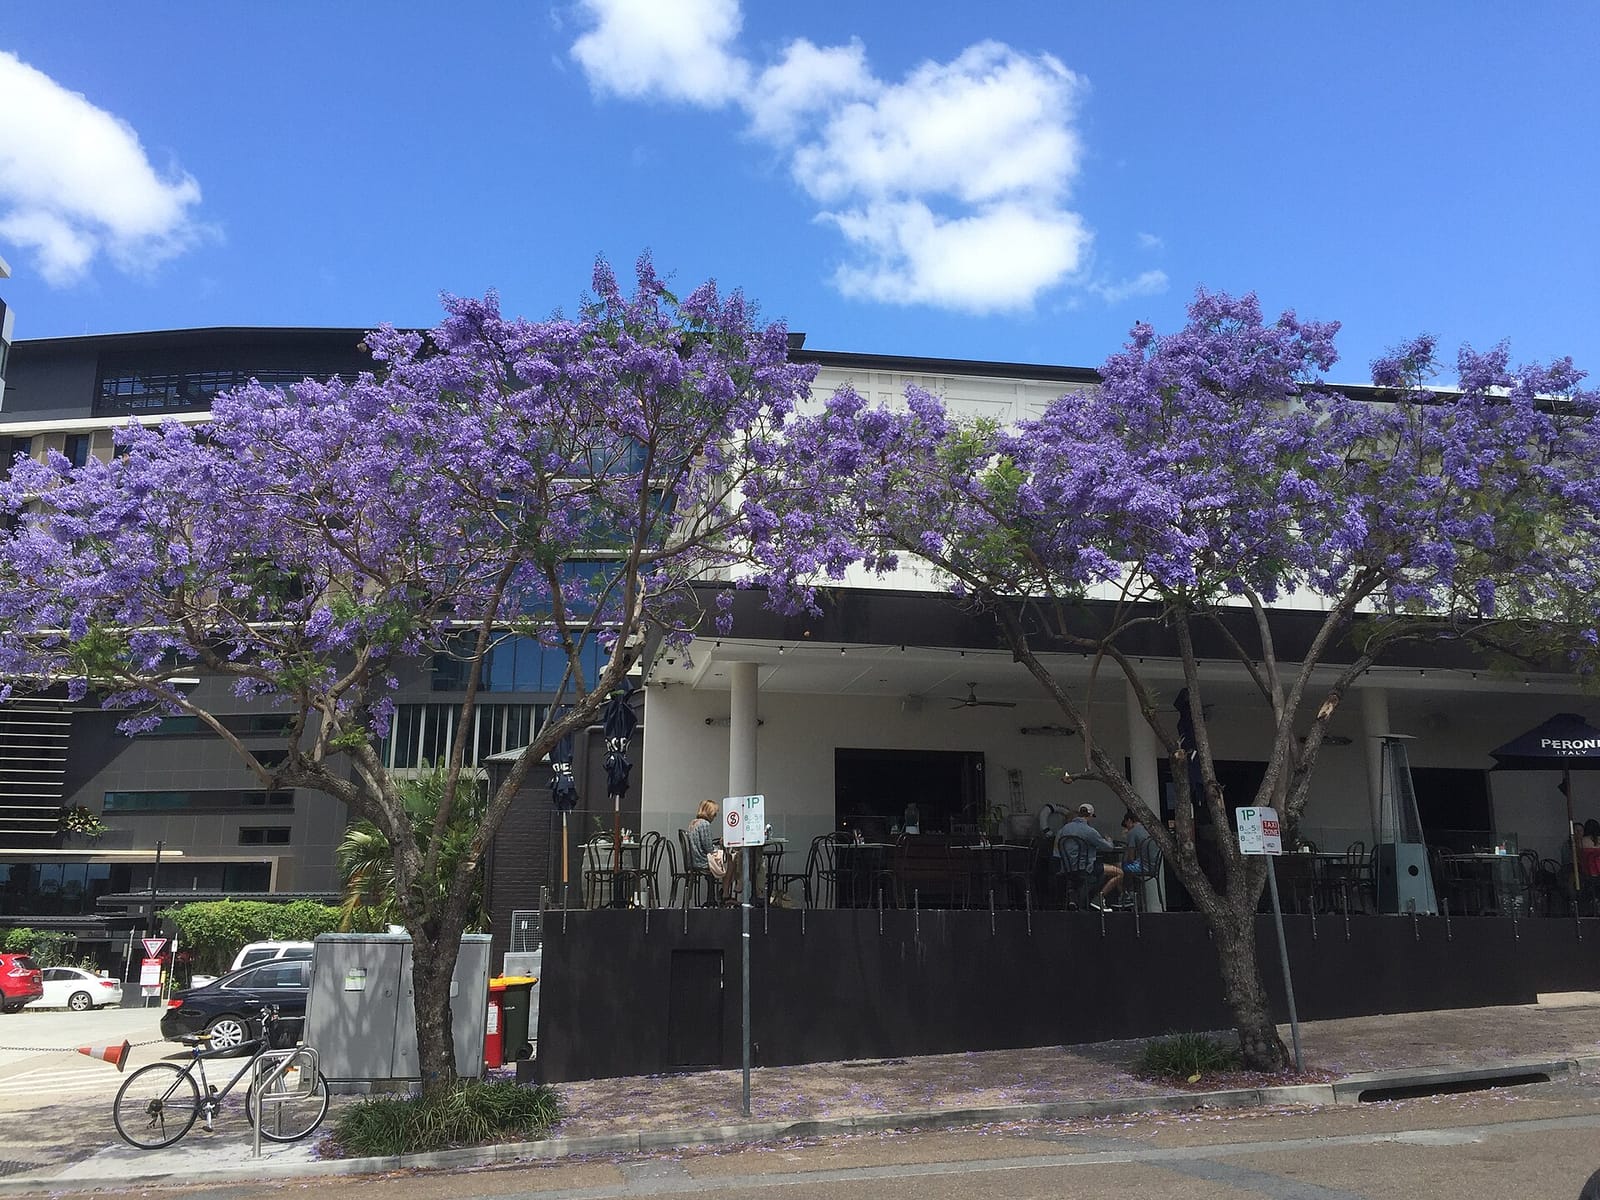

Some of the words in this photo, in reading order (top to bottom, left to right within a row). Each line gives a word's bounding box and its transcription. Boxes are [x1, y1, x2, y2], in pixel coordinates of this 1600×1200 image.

[746, 797, 760, 809] 1P
[1241, 809, 1256, 821] 1P
[1263, 821, 1278, 829] TAXI
